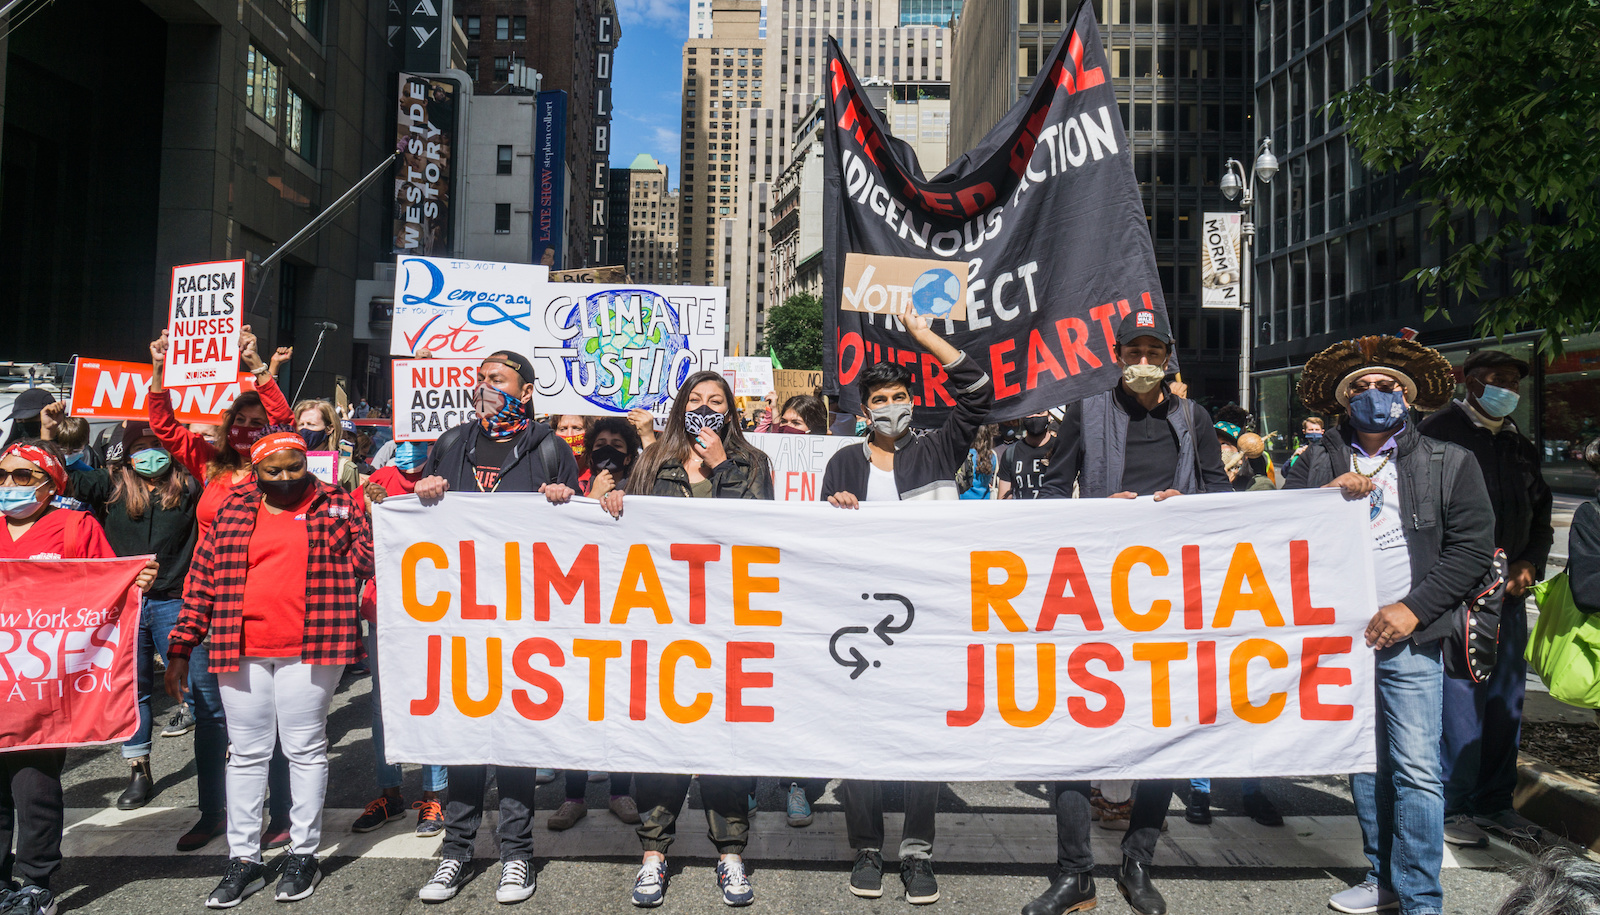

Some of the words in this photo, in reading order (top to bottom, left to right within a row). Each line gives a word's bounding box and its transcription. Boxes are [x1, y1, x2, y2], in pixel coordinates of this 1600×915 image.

[408, 82, 425, 156] SIDE
[543, 101, 553, 132] colbert
[592, 16, 611, 263] COLBERT
[424, 121, 441, 219] STORY
[541, 168, 553, 206] SHOW
[404, 166, 423, 249] WEST
[842, 149, 1004, 257] DIGENOUS
[540, 209, 552, 242] LATE
[177, 272, 236, 294] RACISM
[474, 263, 496, 271] NOT
[563, 273, 595, 283] BIG
[175, 292, 235, 318] KILLS
[412, 307, 427, 315] YOU
[544, 294, 716, 341] CLIMATE
[174, 317, 234, 337] NURSES
[403, 314, 486, 354] Vote
[172, 336, 233, 365] HEAL
[184, 369, 217, 380] NURSES
[411, 366, 482, 389] NURS
[807, 373, 822, 388] NO
[91, 370, 242, 415] NYNA
[774, 436, 824, 473] ARE
[400, 540, 783, 627] CLIMATE
[969, 540, 1336, 633] RACIAL
[26, 607, 73, 628] York
[73, 605, 120, 628] State
[6, 671, 112, 703] ATION
[409, 634, 775, 724] JUSTICE
[946, 635, 1354, 728] JUSTICE
